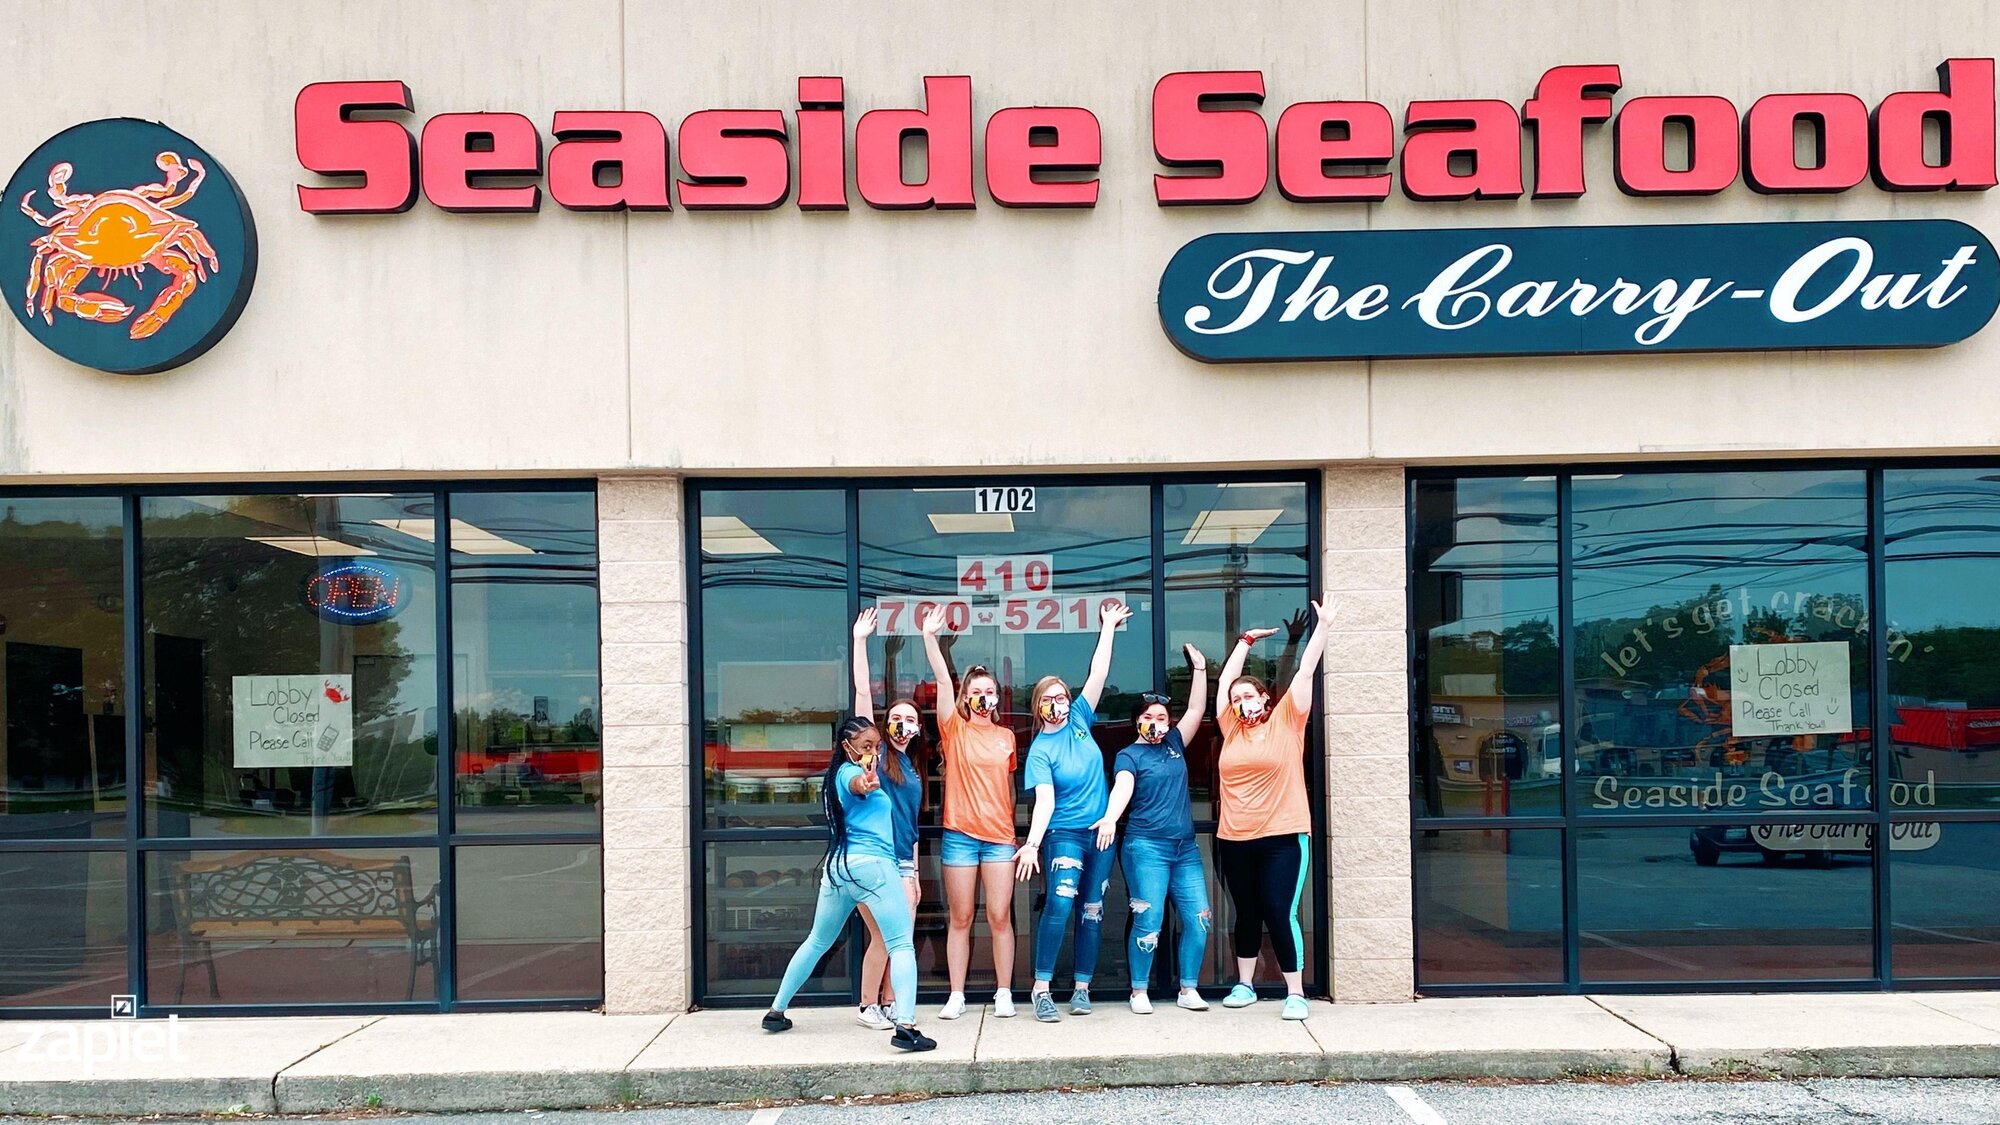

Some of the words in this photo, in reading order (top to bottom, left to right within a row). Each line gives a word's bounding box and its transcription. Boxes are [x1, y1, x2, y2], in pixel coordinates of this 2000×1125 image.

[294, 75, 1103, 213] Seaside
[1152, 58, 1999, 206] Seafood
[1184, 248, 1390, 336] The
[1401, 236, 1979, 346] Carry-Out
[978, 487, 1034, 512] 1702
[960, 560, 1049, 592] 410
[307, 576, 400, 608] OPEN
[1601, 617, 1684, 677] let's
[1692, 586, 1751, 634] get
[1757, 646, 1818, 677] Lobby
[250, 678, 313, 710] Lobby
[1759, 677, 1819, 700] Closed
[273, 704, 320, 725] Closed
[1742, 700, 1783, 720] Please
[1789, 701, 1811, 718] Call
[249, 730, 289, 750] Please
[292, 730, 313, 748] Call
[1765, 719, 1803, 733] Thank
[1593, 772, 1746, 809] Seaside
